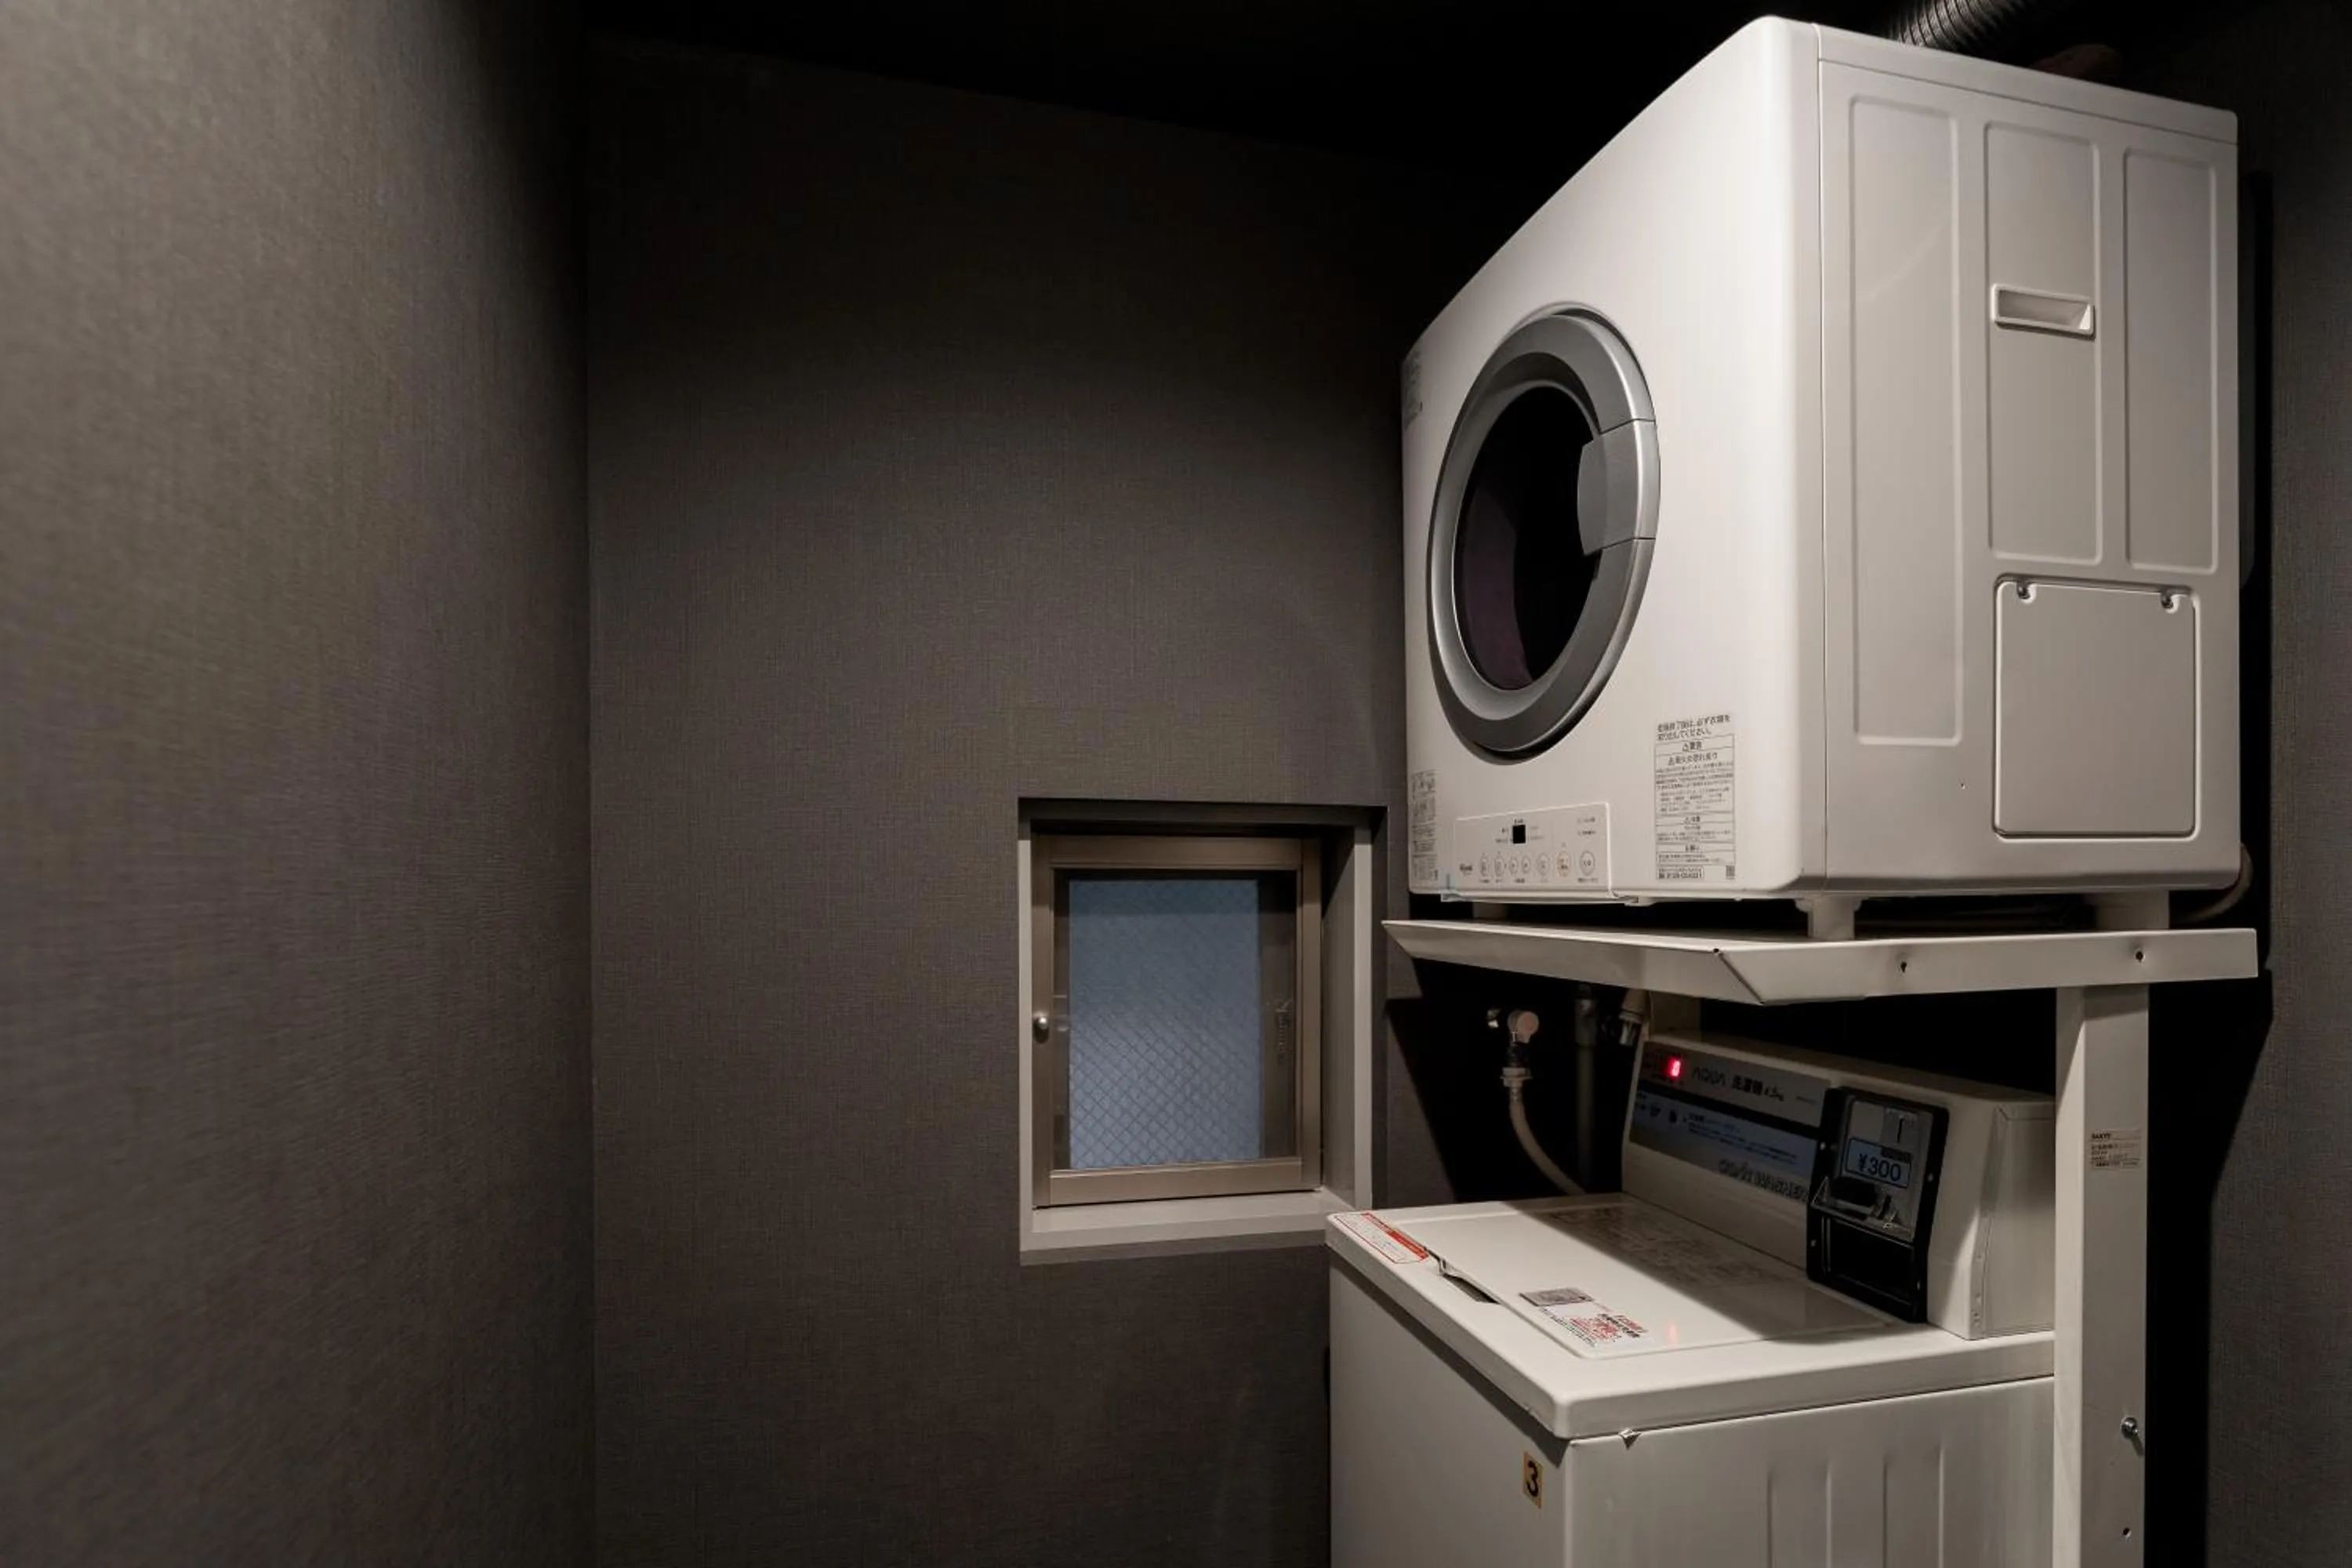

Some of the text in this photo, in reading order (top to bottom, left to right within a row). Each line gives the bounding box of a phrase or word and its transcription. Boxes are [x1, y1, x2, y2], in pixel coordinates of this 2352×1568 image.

[1731, 1075, 1763, 1096] 洗濯機
[1858, 1153, 1902, 1182] ¥300
[1527, 1461, 1539, 1497] 3
